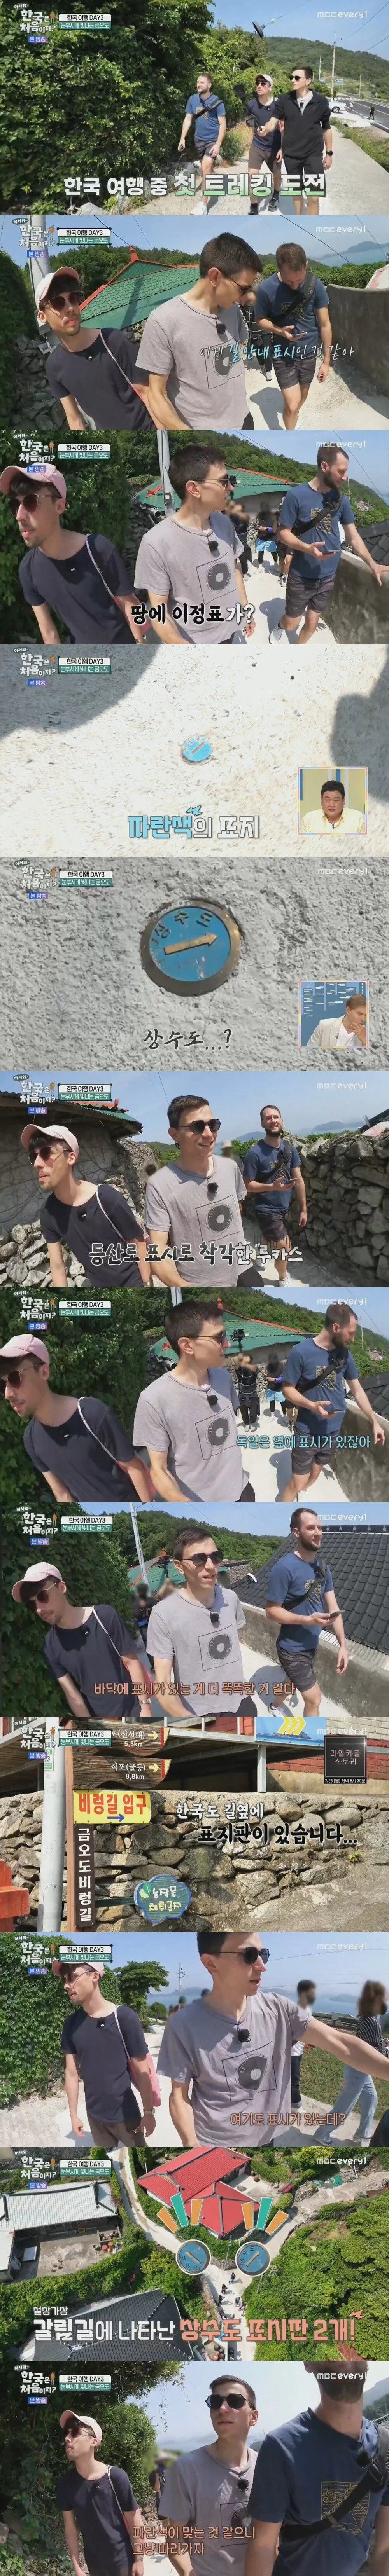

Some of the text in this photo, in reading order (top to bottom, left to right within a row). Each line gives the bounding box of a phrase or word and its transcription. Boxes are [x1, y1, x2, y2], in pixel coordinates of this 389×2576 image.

[79, 1794, 146, 1814] 비렁길 입구
[152, 1886, 177, 1898] 농작물
